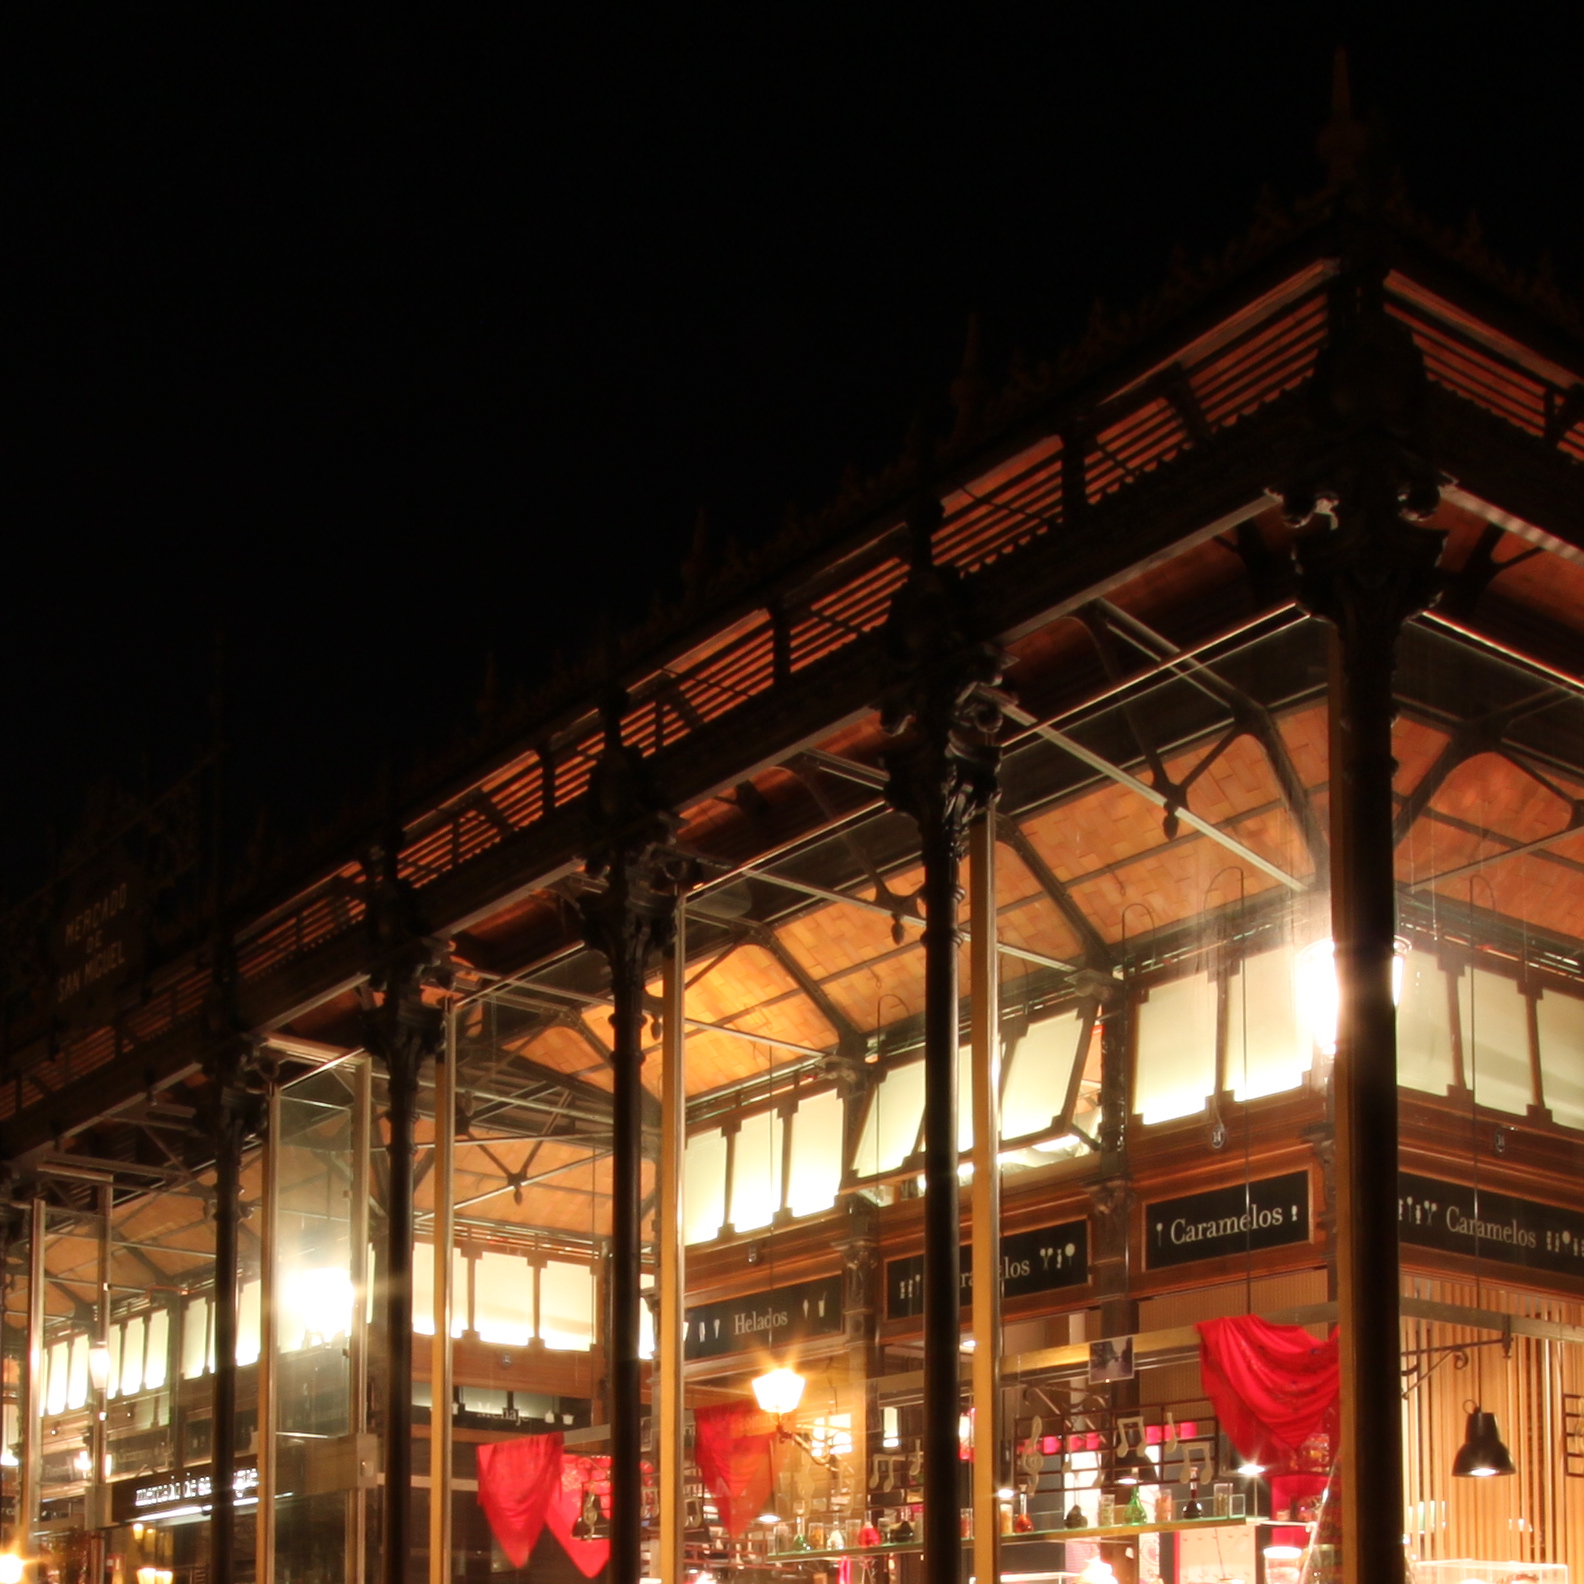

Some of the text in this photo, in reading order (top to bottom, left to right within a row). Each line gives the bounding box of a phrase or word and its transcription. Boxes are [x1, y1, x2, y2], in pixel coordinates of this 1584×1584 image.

[65, 883, 127, 947] MERCADO
[86, 929, 102, 954] DE
[1170, 1203, 1283, 1245] Caramelos
[1446, 1206, 1537, 1249] Caramelos
[734, 1307, 788, 1336] Helados
